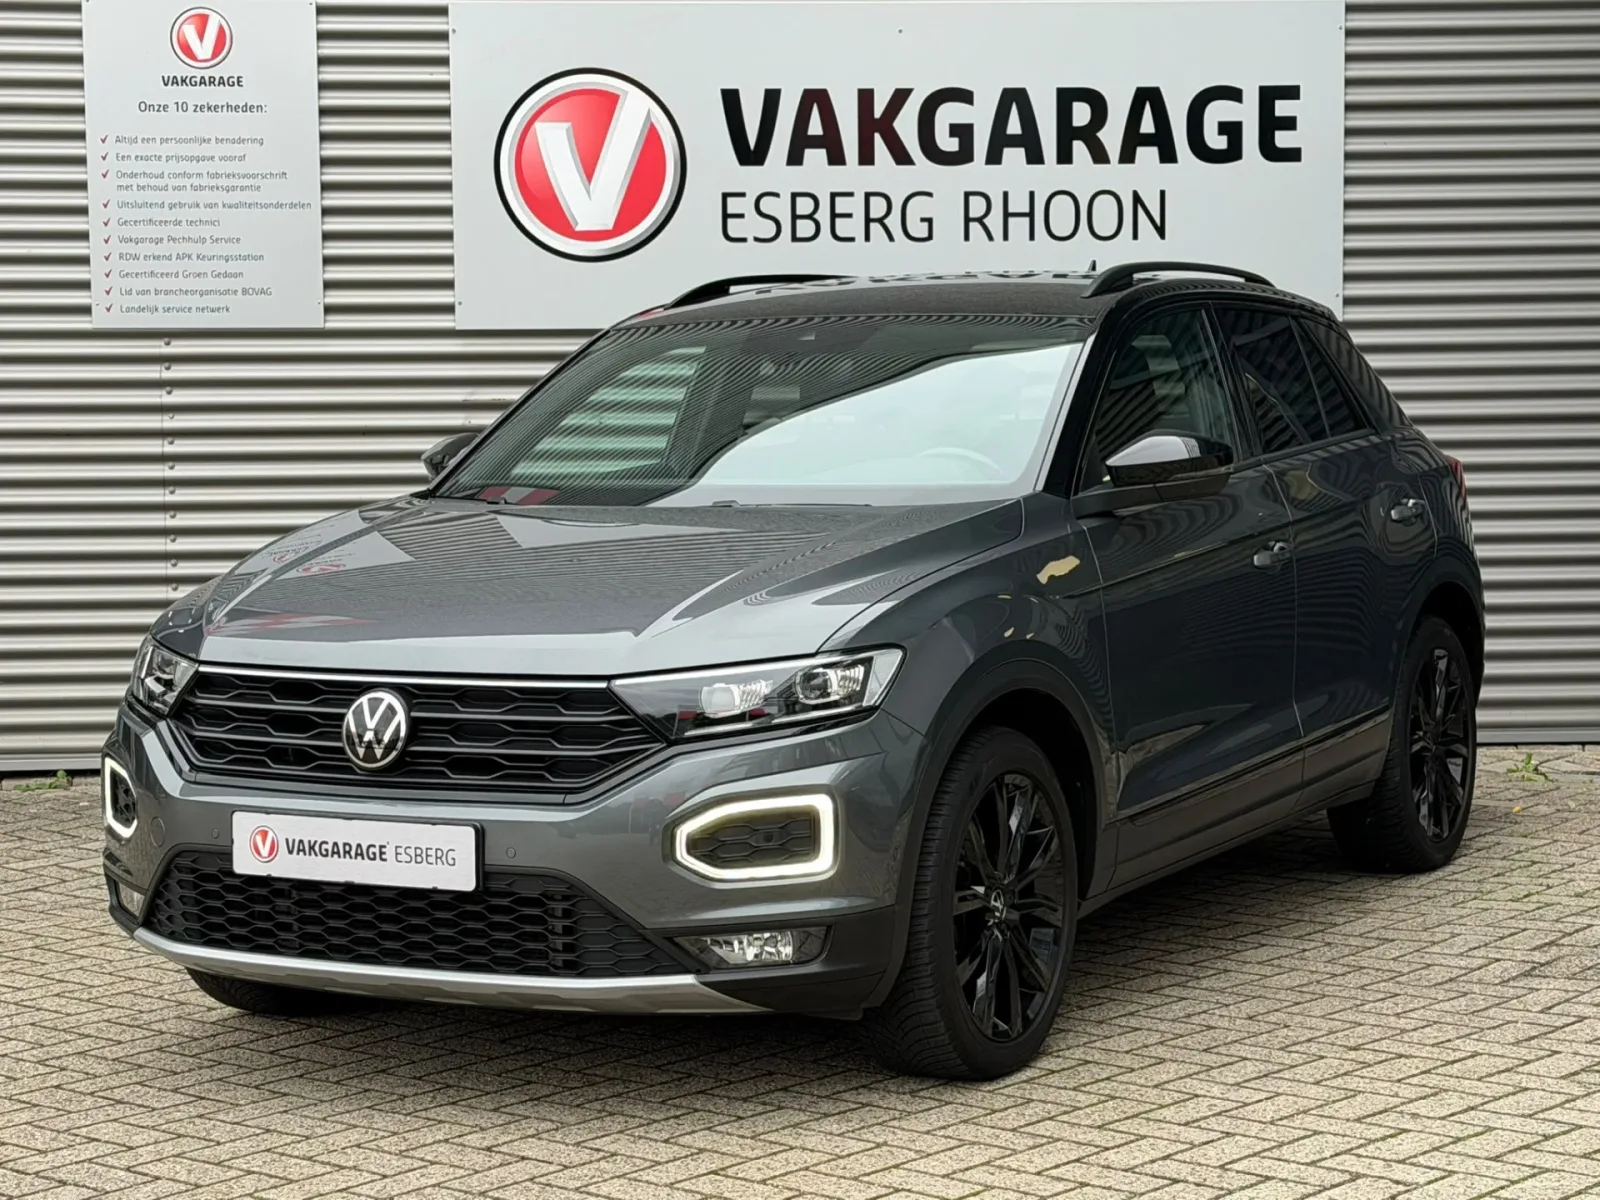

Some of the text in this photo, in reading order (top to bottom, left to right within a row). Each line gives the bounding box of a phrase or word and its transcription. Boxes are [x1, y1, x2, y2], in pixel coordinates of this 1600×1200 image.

[162, 76, 243, 87] VAKGARAGE
[138, 101, 267, 113] Onze 10 zekerheden:
[720, 85, 1301, 167] VAKGARAGE
[115, 135, 138, 145] Altijd
[160, 136, 211, 146] persoonlijke
[215, 136, 264, 146] benadering
[116, 153, 131, 161] Een
[166, 153, 215, 163] prijsopgave
[218, 154, 246, 162] vooraf
[116, 171, 287, 179] Onderhoud conform fabrieksvoorschrift
[137, 183, 168, 191] behoud
[190, 183, 261, 193] fabrieksgarantie
[117, 201, 165, 209] Uitsluitend
[168, 201, 200, 211] gebruik
[222, 201, 311, 209] kwaliteitsonderdelen
[721, 189, 1167, 243] ESBERG RHOON
[118, 218, 220, 226] Gecertificeerde technici
[118, 236, 241, 245] Vakgarage Pechhulp Service
[119, 253, 264, 263] RDW erkend APK Keuringsstation
[119, 270, 243, 278] Gecertificeerd Groen Gedaan
[120, 288, 133, 296] Lid
[155, 288, 238, 297] brancheorganisatie
[242, 288, 272, 296] BOVAG
[120, 305, 230, 315] Landelijk service netwerk
[395, 845, 456, 866] ESBERG
